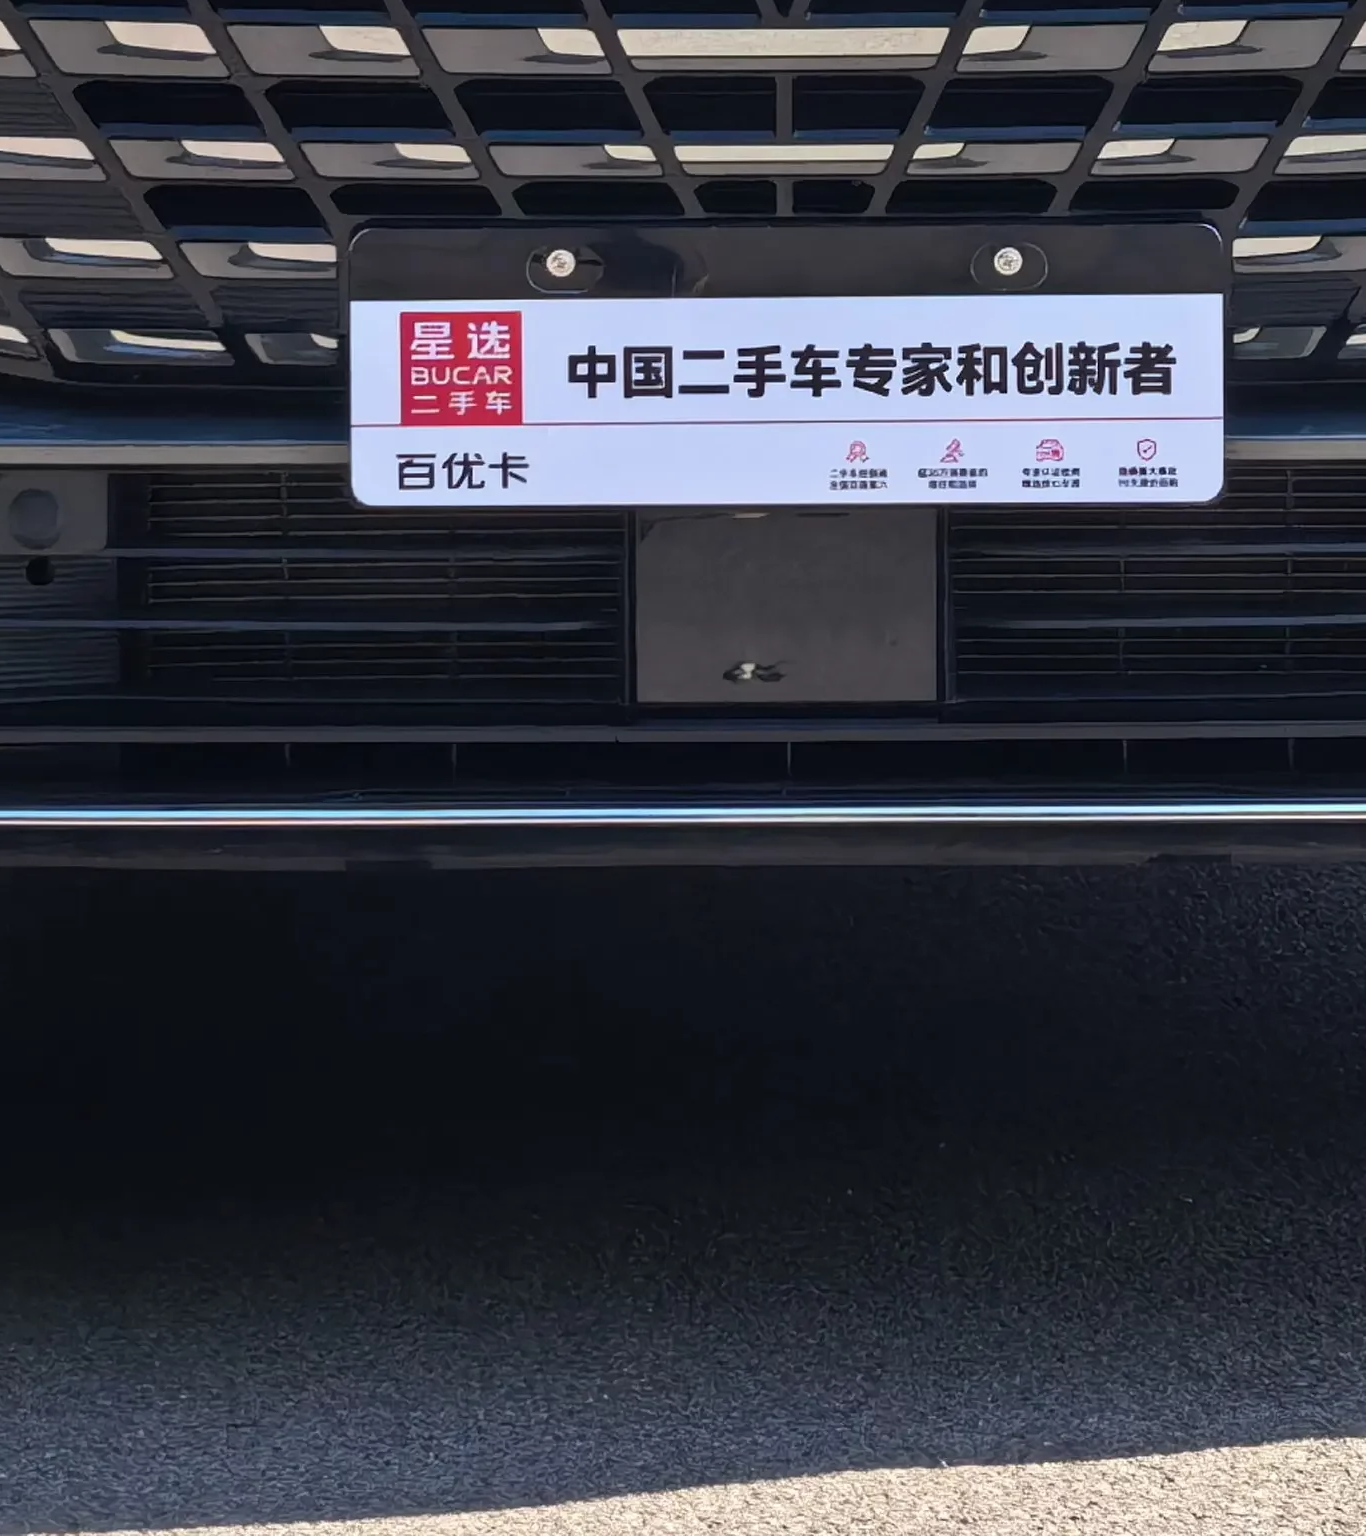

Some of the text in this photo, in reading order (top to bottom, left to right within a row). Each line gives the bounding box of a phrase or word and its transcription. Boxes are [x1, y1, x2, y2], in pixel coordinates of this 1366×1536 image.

[410, 320, 511, 361] 星选
[411, 365, 513, 385] BUCAR
[567, 341, 1178, 400] 中国二手车专家和创新者
[411, 390, 513, 416] 二手车
[395, 452, 530, 491] 百优卡
